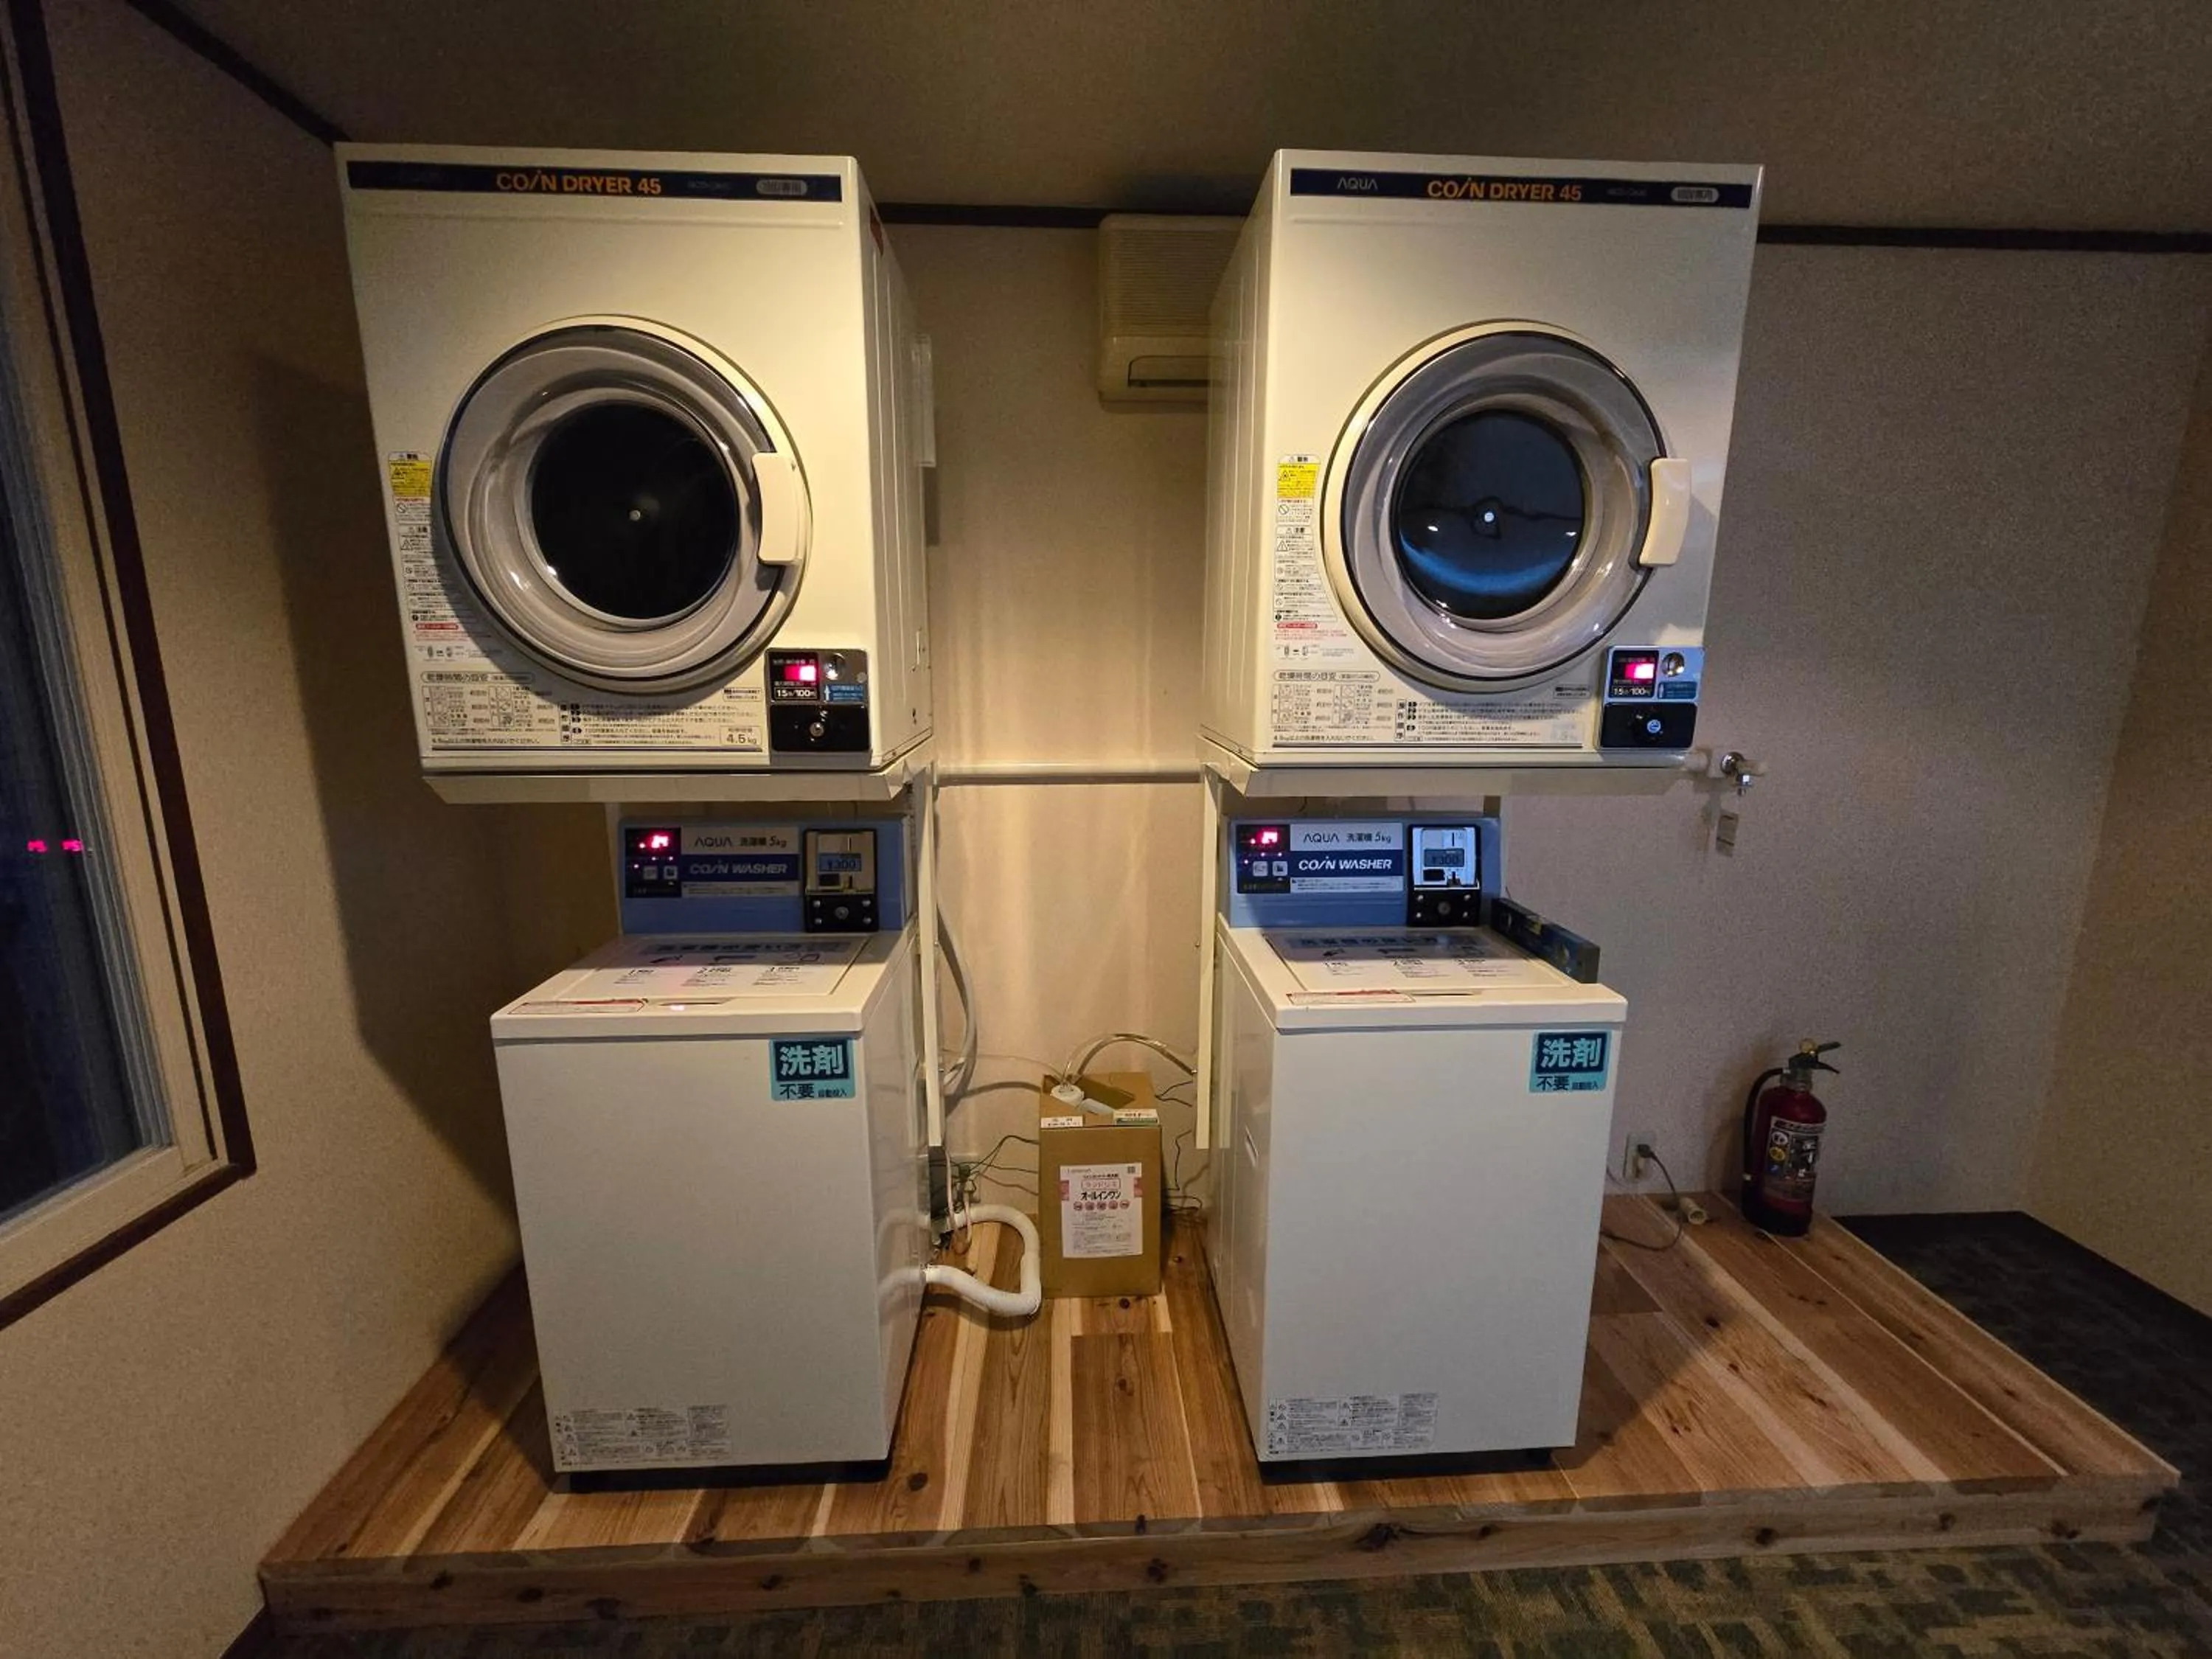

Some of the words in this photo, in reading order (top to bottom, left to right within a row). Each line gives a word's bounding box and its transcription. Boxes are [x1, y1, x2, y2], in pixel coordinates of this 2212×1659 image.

[561, 175, 632, 194] DRYER
[638, 178, 662, 195] 45
[1337, 176, 1378, 190] AQUA
[1489, 183, 1554, 201] DRYER
[1559, 185, 1582, 201] 45
[695, 836, 733, 847] AQUA
[1303, 832, 1340, 843] AQUA
[731, 863, 787, 874] WASHER
[1338, 859, 1393, 869] WASHER
[1540, 1037, 1602, 1068] 洗剤
[779, 1045, 844, 1076] 洗剤
[1537, 1076, 1569, 1091] 不要
[779, 1083, 815, 1099] 不要
[1081, 1191, 1121, 1201] オールインワン
